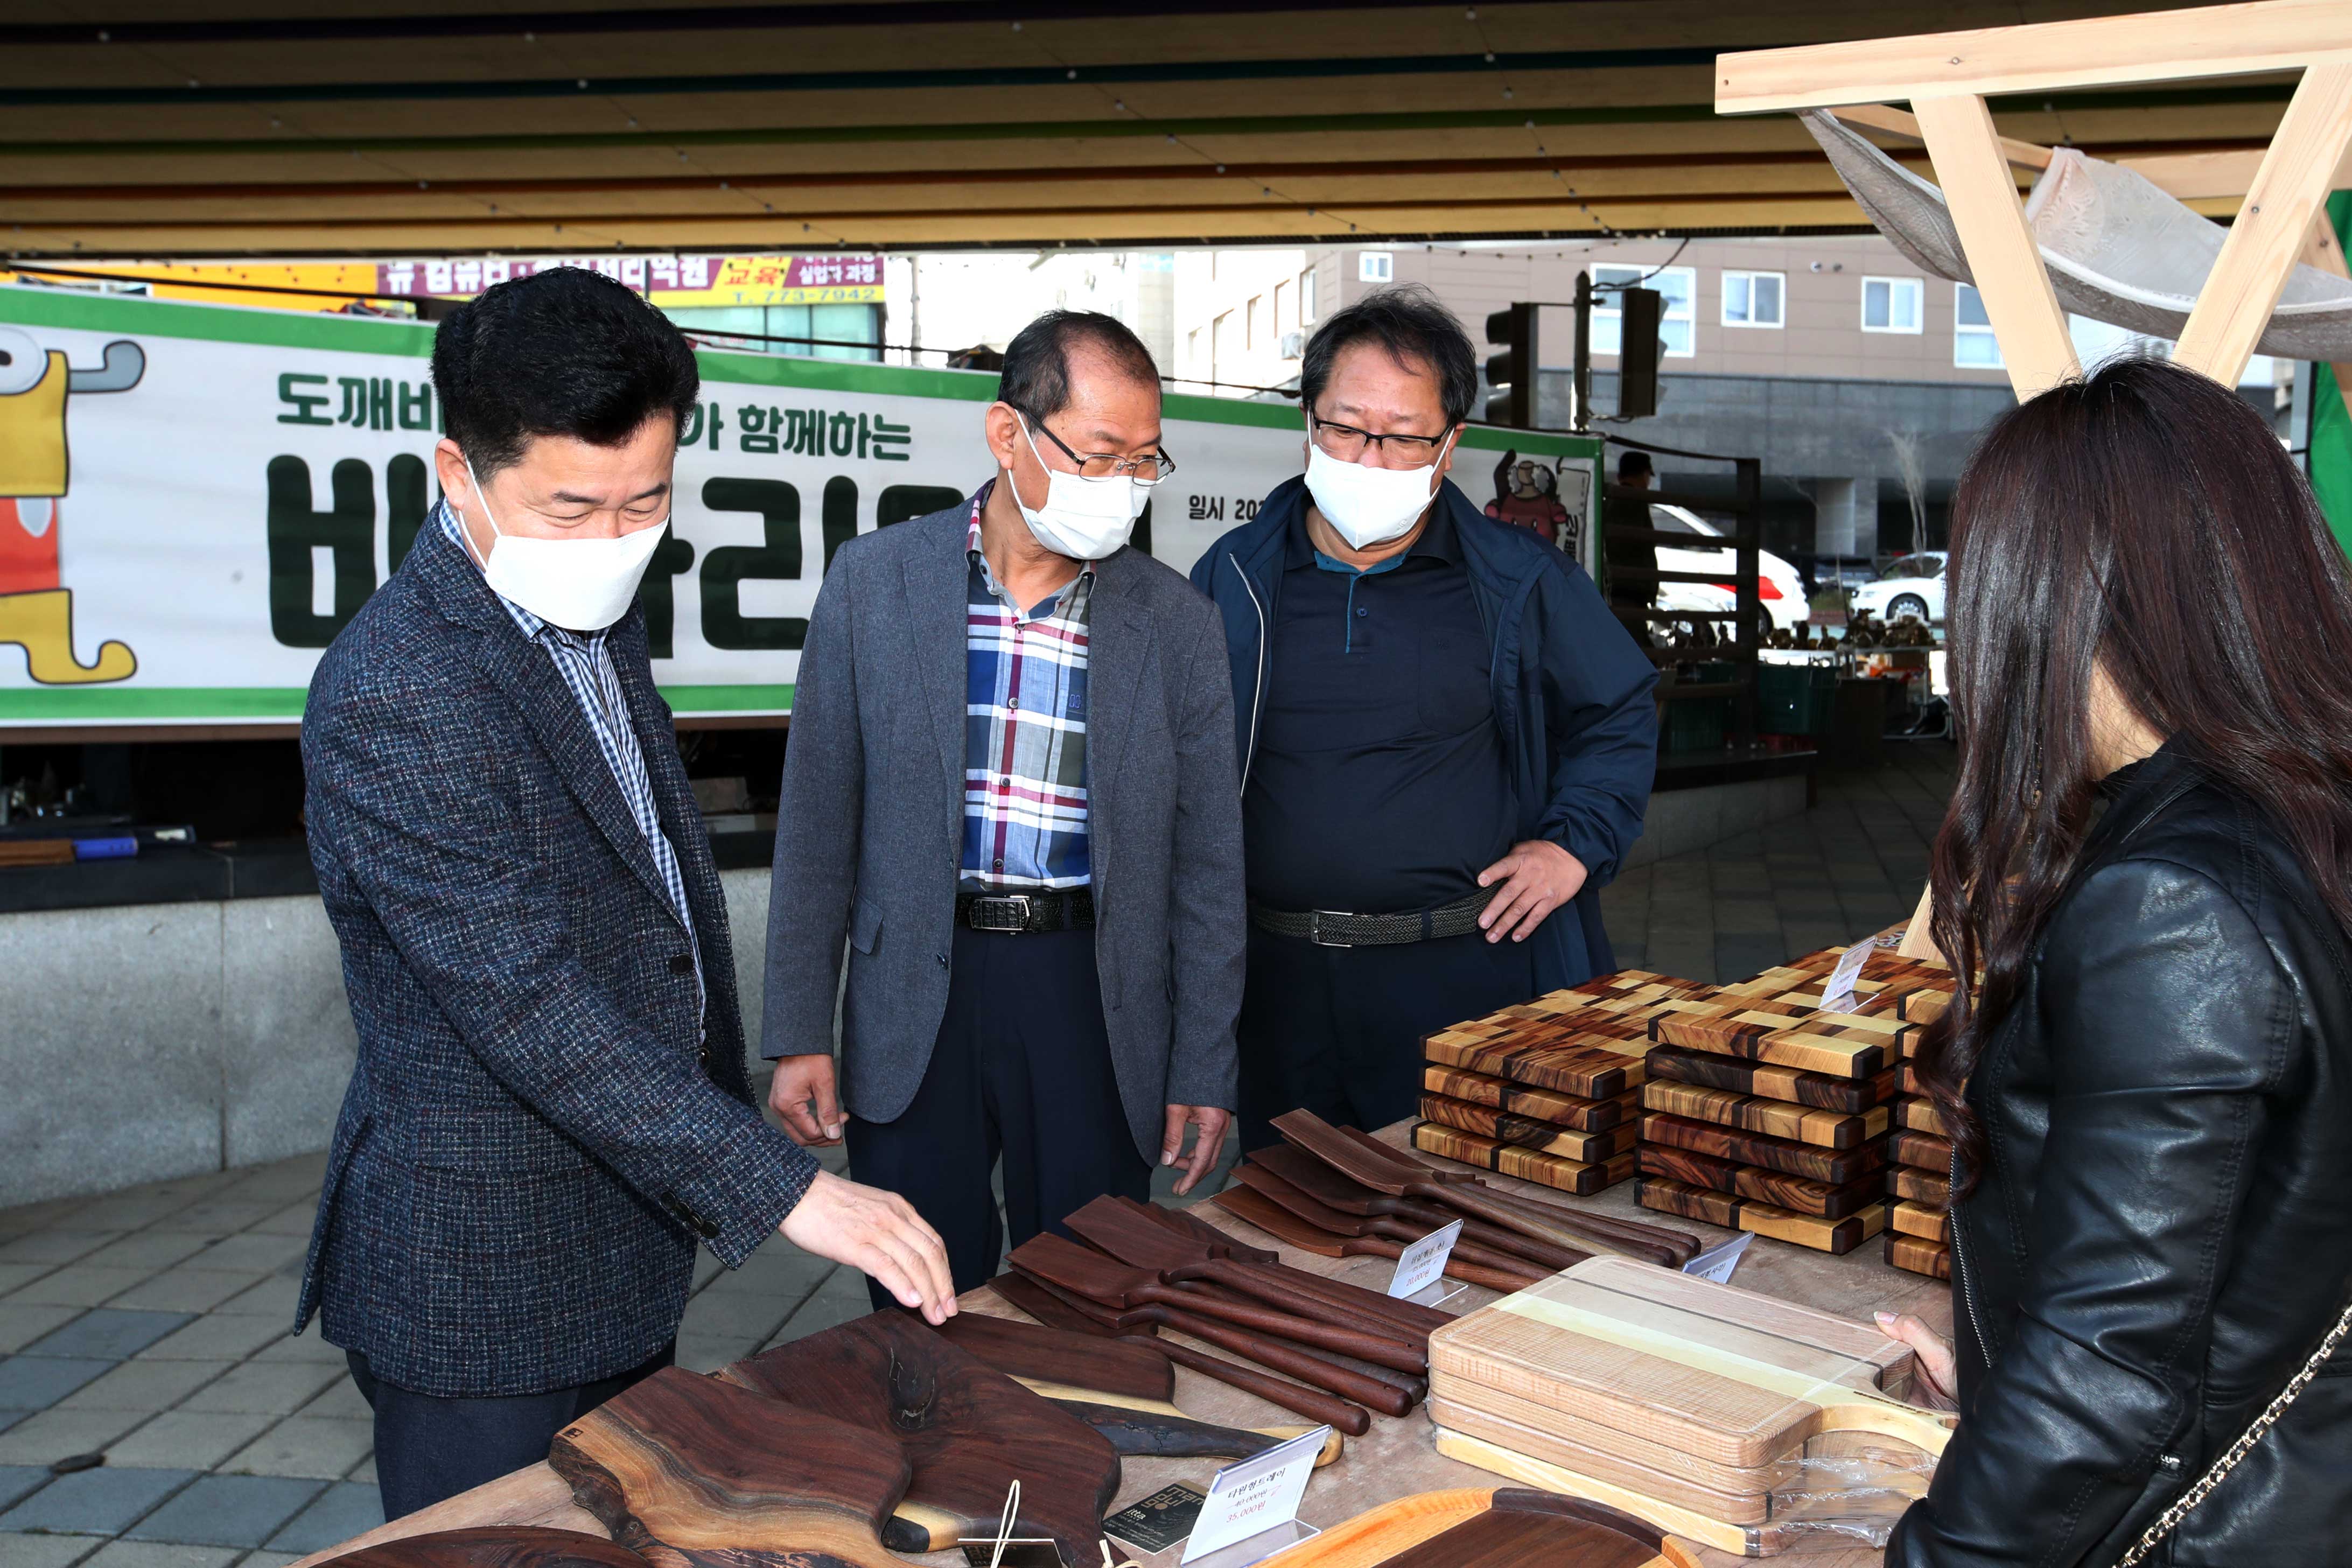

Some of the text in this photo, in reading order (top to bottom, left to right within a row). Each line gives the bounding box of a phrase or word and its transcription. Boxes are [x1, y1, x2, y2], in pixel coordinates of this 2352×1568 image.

[737, 404, 912, 461] 함께하는
[1189, 495, 1265, 521] 일시 20
